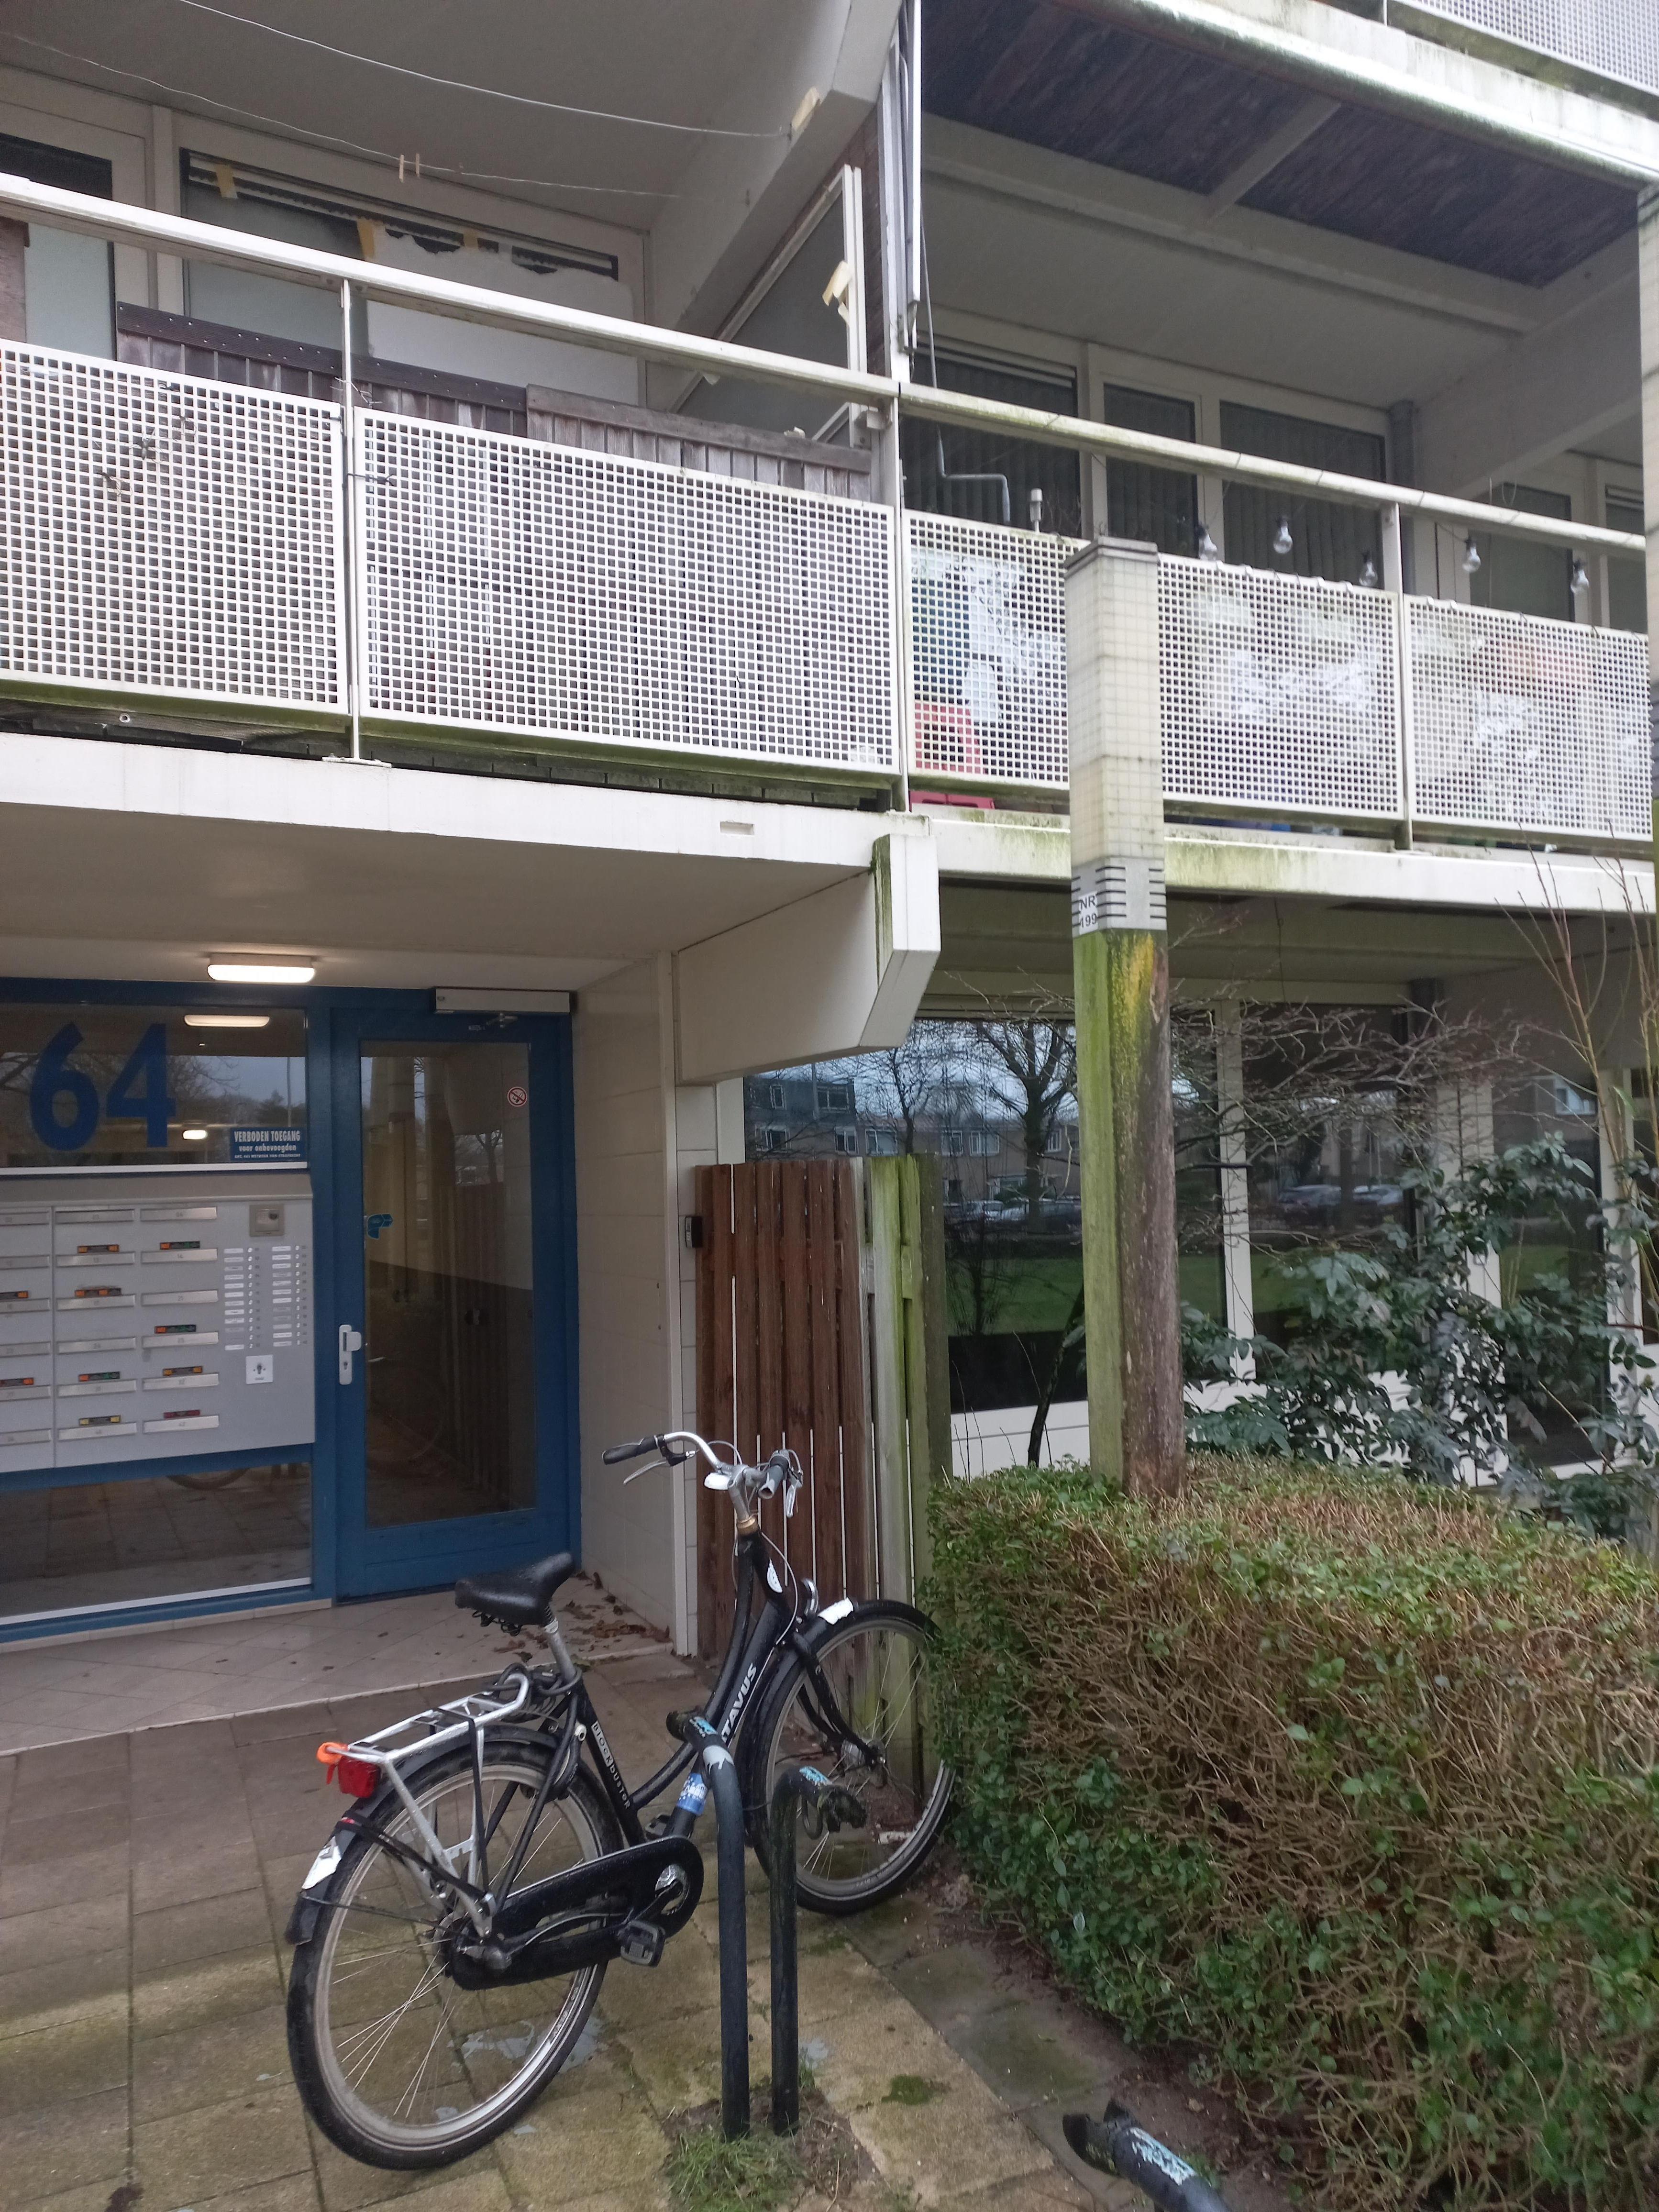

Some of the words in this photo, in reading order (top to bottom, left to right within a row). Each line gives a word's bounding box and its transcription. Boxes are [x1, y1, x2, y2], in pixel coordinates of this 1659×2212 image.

[1079, 895, 1096, 910] NR
[1079, 913, 1097, 928] 199
[30, 1021, 176, 1151] 64
[234, 1131, 269, 1142] VERBODEN
[271, 1130, 301, 1141] TOEGANG
[254, 1143, 297, 1153] onbevoegden
[721, 1662, 757, 1743] TAVUS
